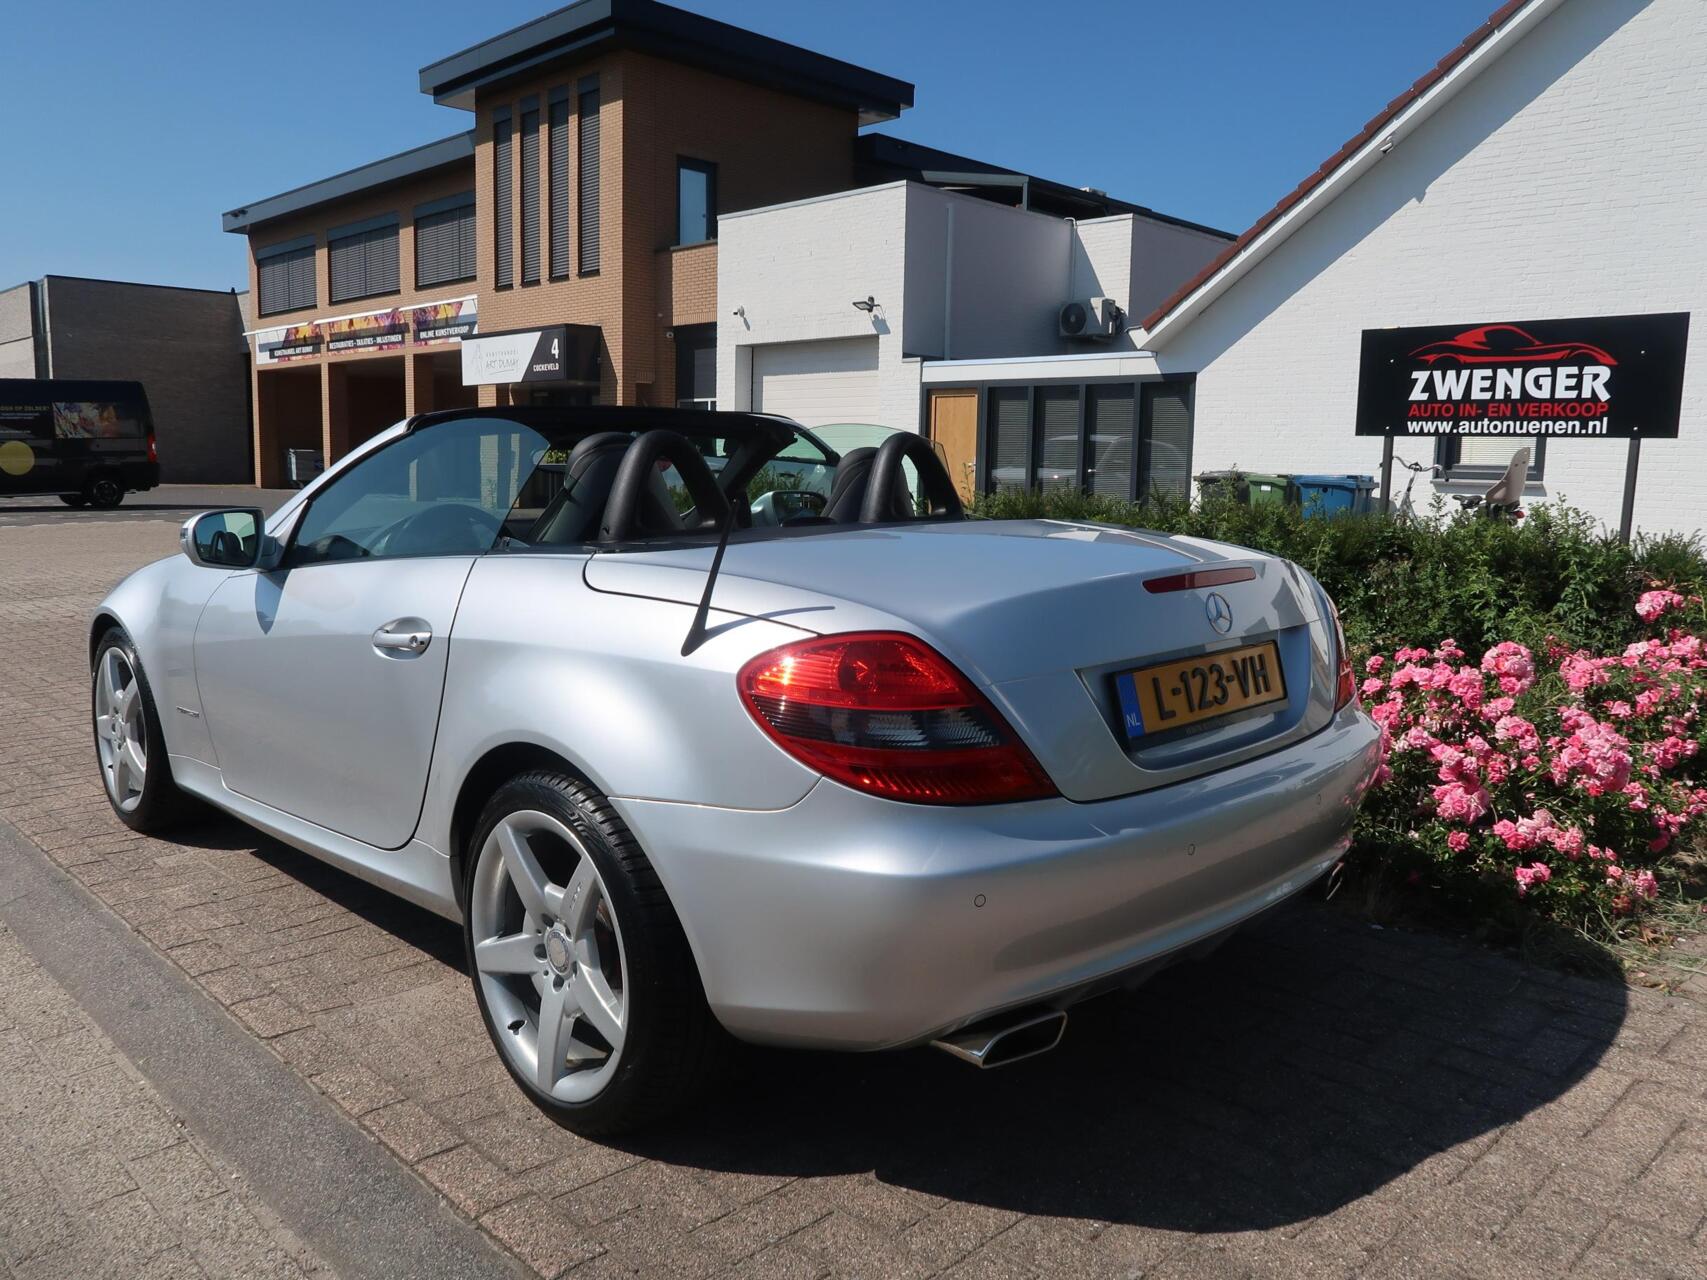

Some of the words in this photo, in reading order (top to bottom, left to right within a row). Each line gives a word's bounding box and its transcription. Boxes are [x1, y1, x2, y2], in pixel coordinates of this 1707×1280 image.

[551, 338, 559, 359] 4
[533, 363, 559, 372] COCKEVELD
[1408, 365, 1611, 402] ZWENGER
[1408, 402, 1454, 417] AUTO
[1459, 402, 1482, 417] IN-
[1488, 402, 1513, 417] EN
[1516, 401, 1609, 417] VERKOOP
[1407, 416, 1608, 435] www.autonuenen.nl
[1152, 654, 1271, 721] L-123-VH
[1126, 714, 1141, 727] NL
